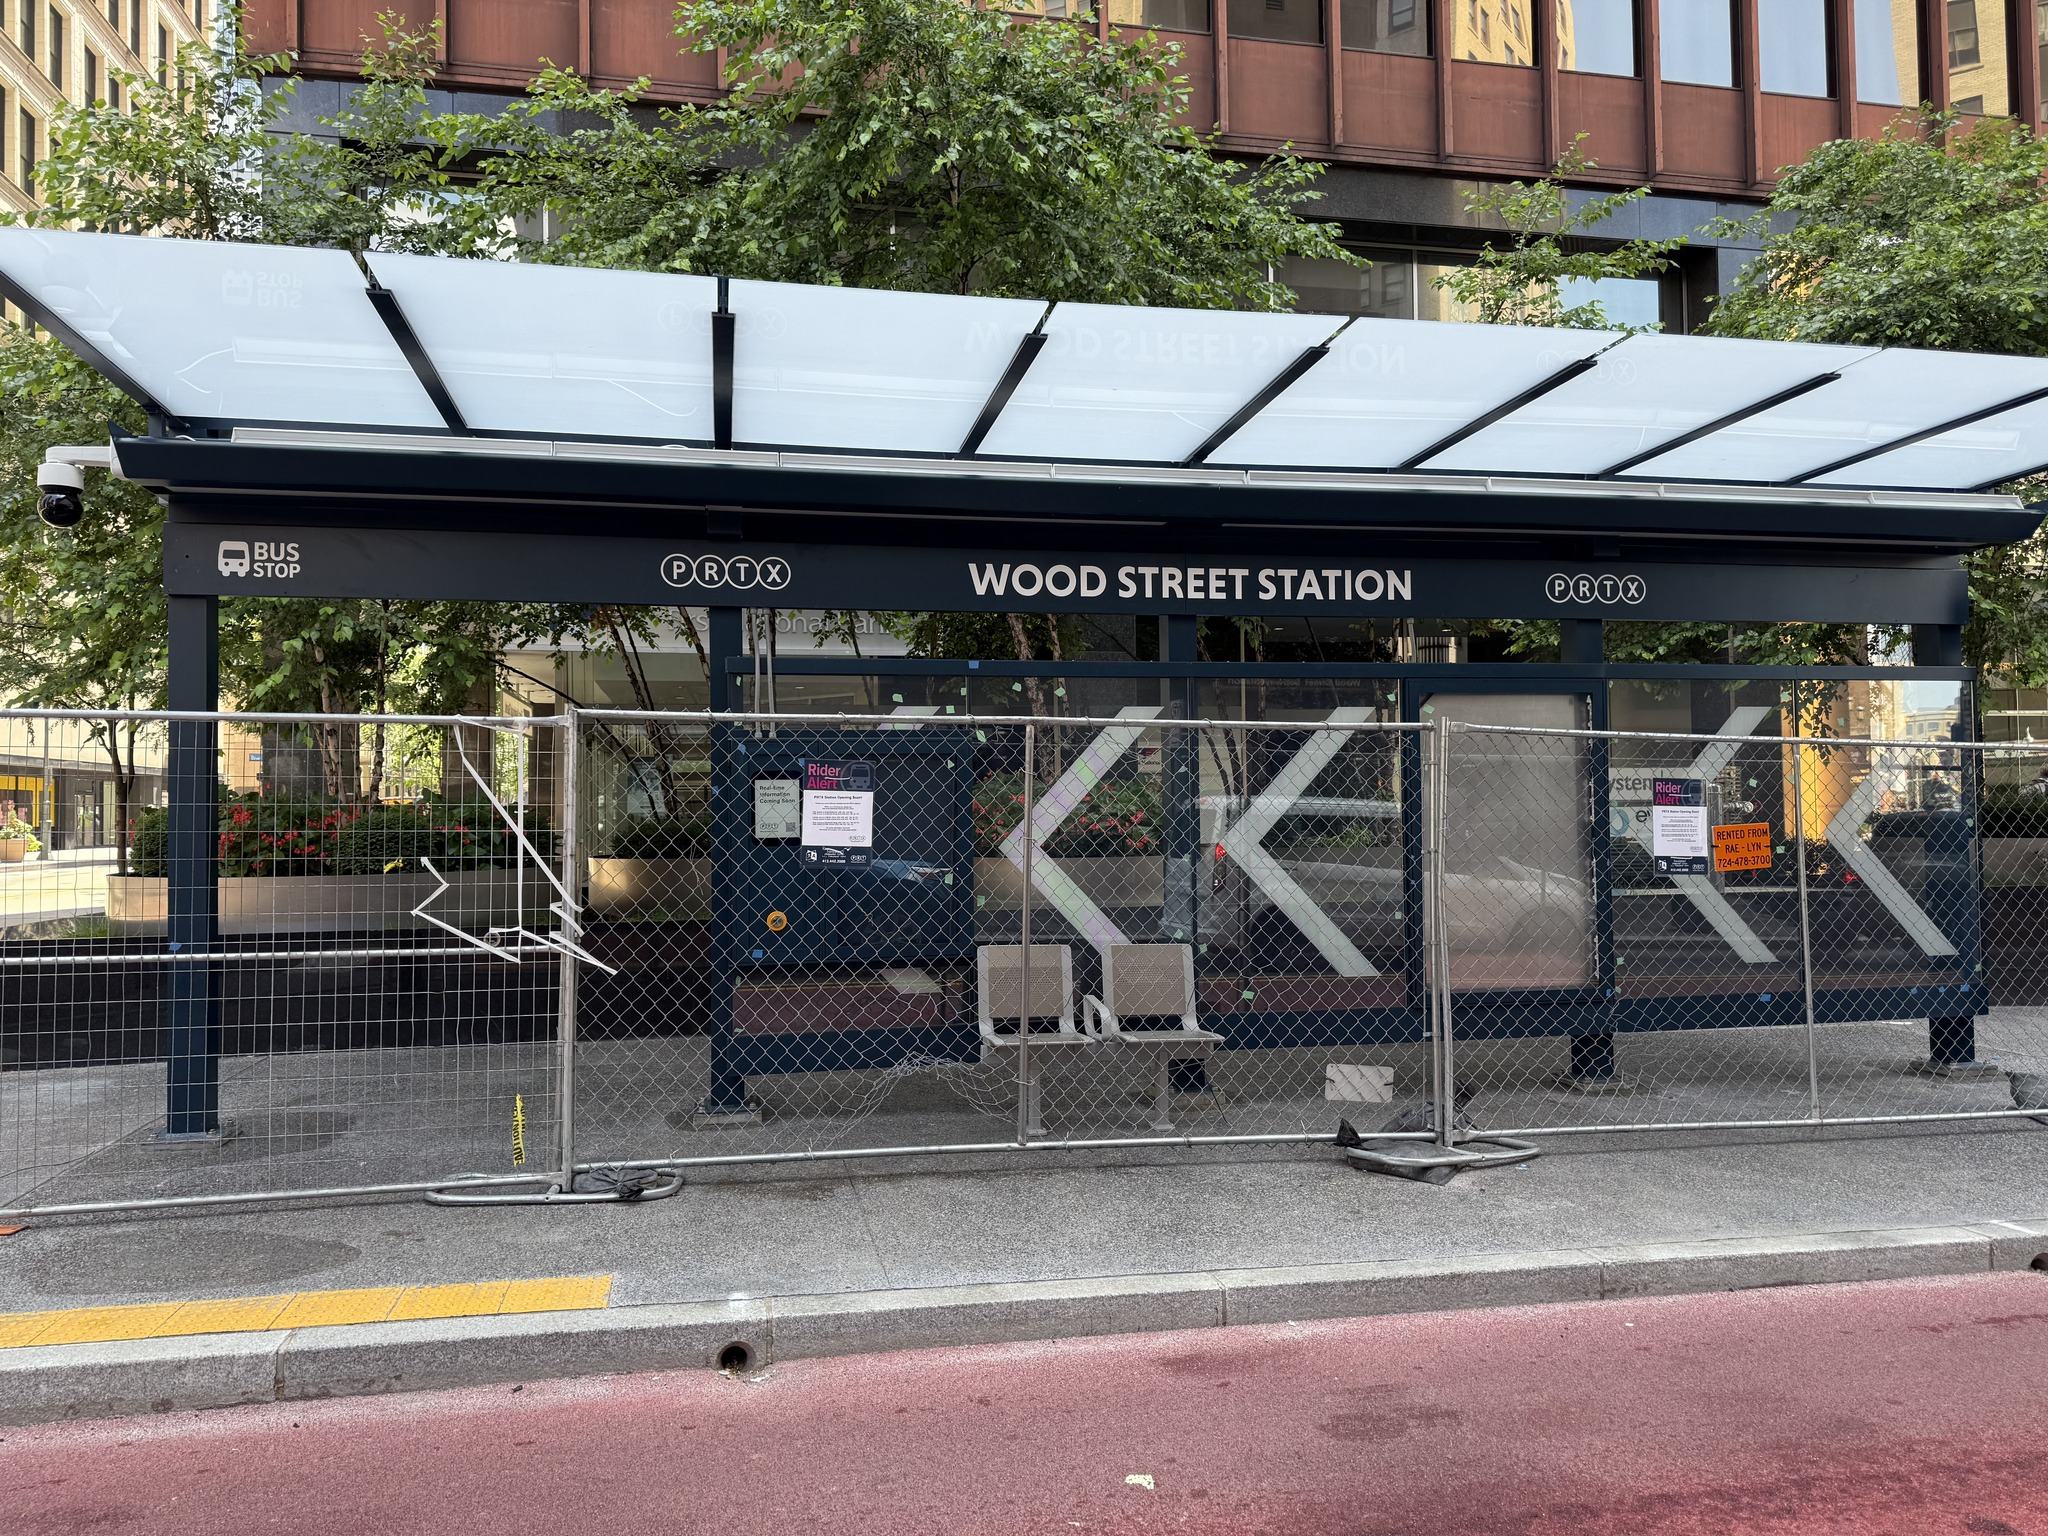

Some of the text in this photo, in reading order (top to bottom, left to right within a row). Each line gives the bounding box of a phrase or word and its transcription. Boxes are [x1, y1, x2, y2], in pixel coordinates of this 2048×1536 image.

[254, 542, 300, 561] BUS
[253, 562, 301, 578] STOP
[663, 555, 789, 588] PRTX
[968, 563, 1412, 601] WOOD STREET STATION
[1547, 575, 1644, 603] PRTX
[808, 763, 841, 777] Rider
[807, 777, 838, 789] Alert
[1655, 781, 1682, 793] Rider
[1655, 793, 1680, 805] Alert
[1716, 828, 1768, 840] RENTED FROM
[1725, 843, 1740, 854] RAE
[1746, 842, 1762, 852] LYN
[1717, 855, 1770, 868] 724-478-3700
